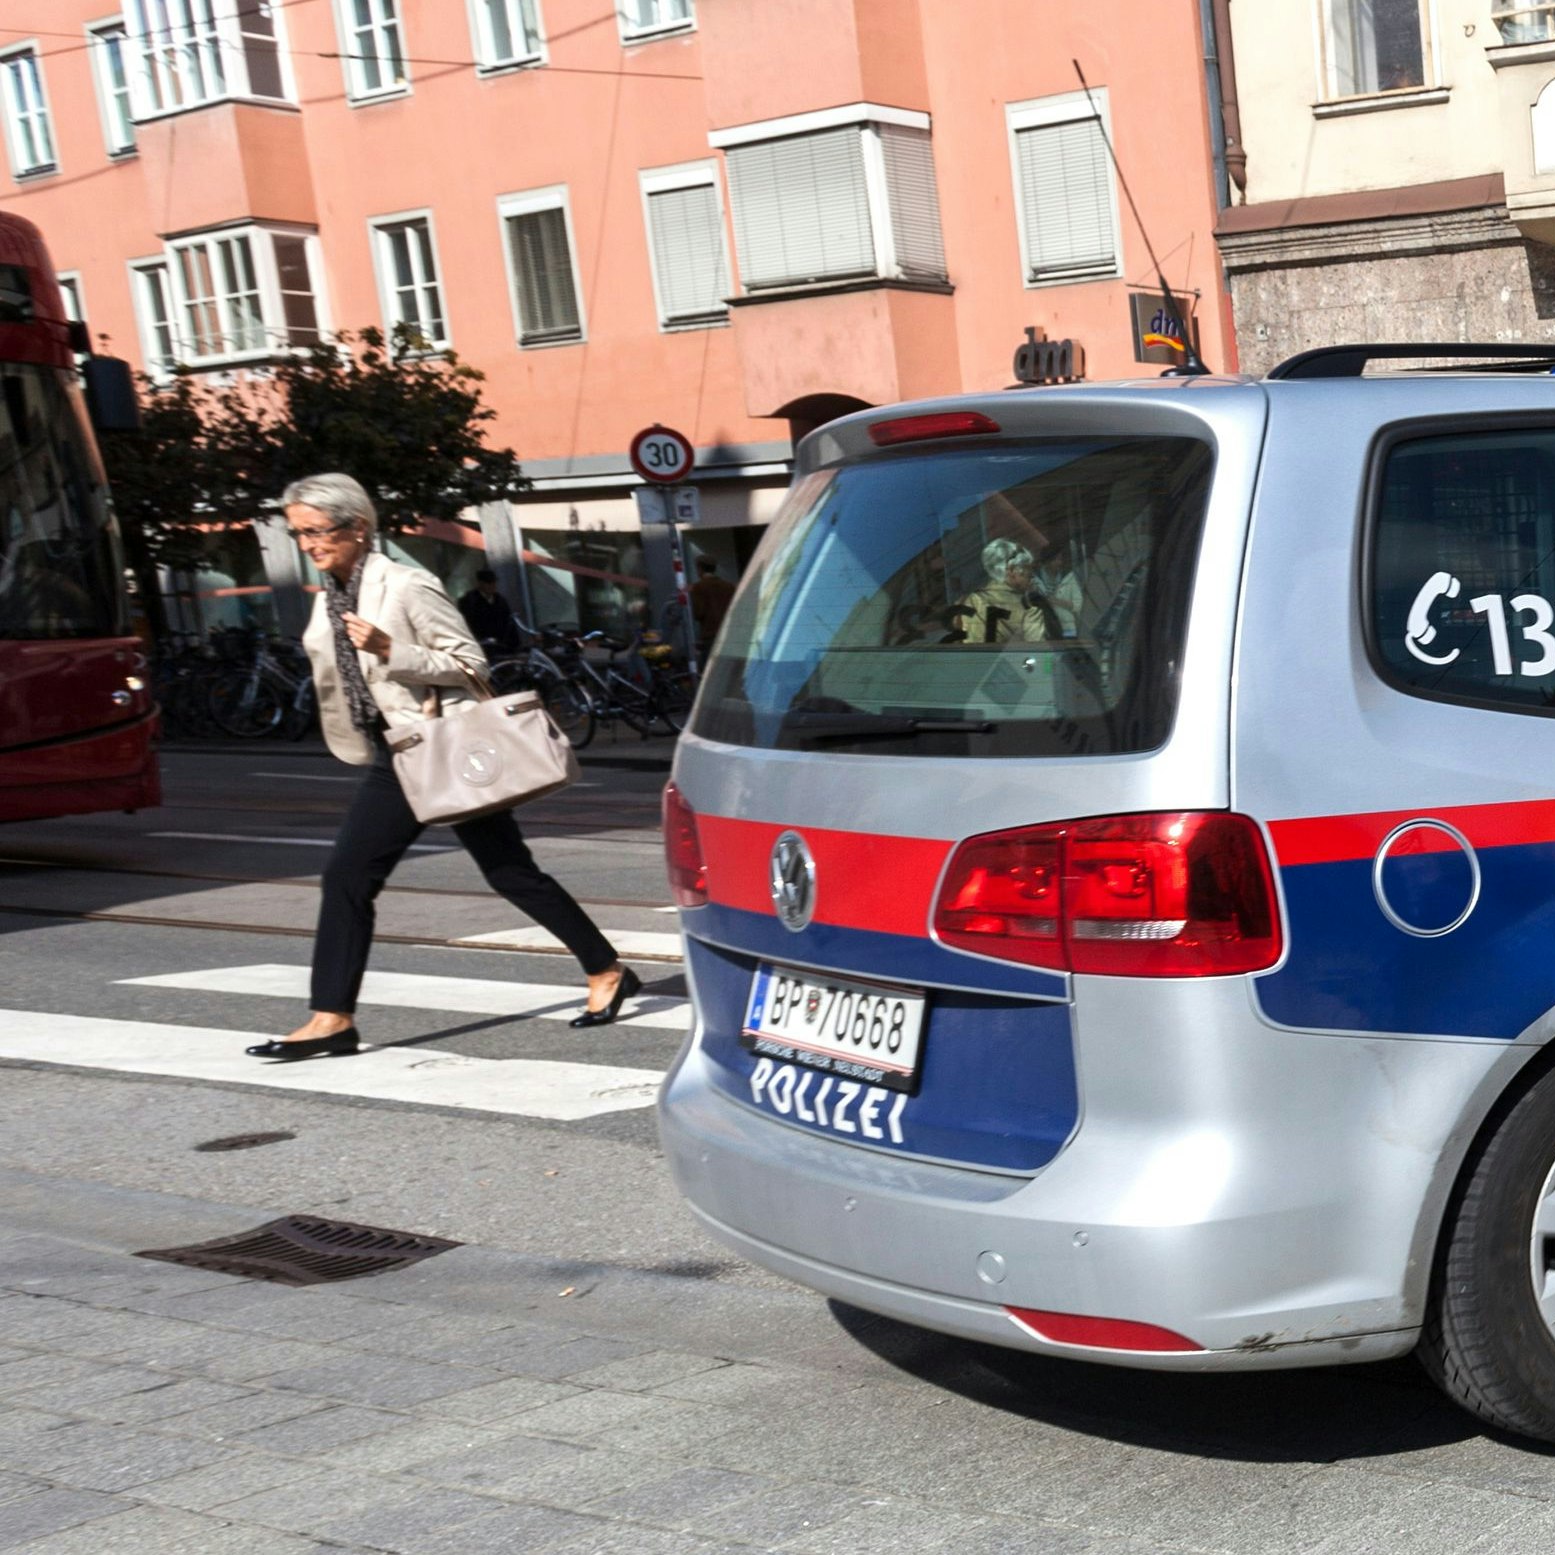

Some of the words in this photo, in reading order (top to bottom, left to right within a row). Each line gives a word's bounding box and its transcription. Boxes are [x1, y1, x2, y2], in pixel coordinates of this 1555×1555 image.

[1151, 309, 1185, 337] dm
[1014, 326, 1085, 383] dm
[645, 442, 679, 467] 30
[770, 975, 804, 1028] BP
[817, 986, 906, 1055] 70668
[750, 1057, 908, 1144] POLIZEI
